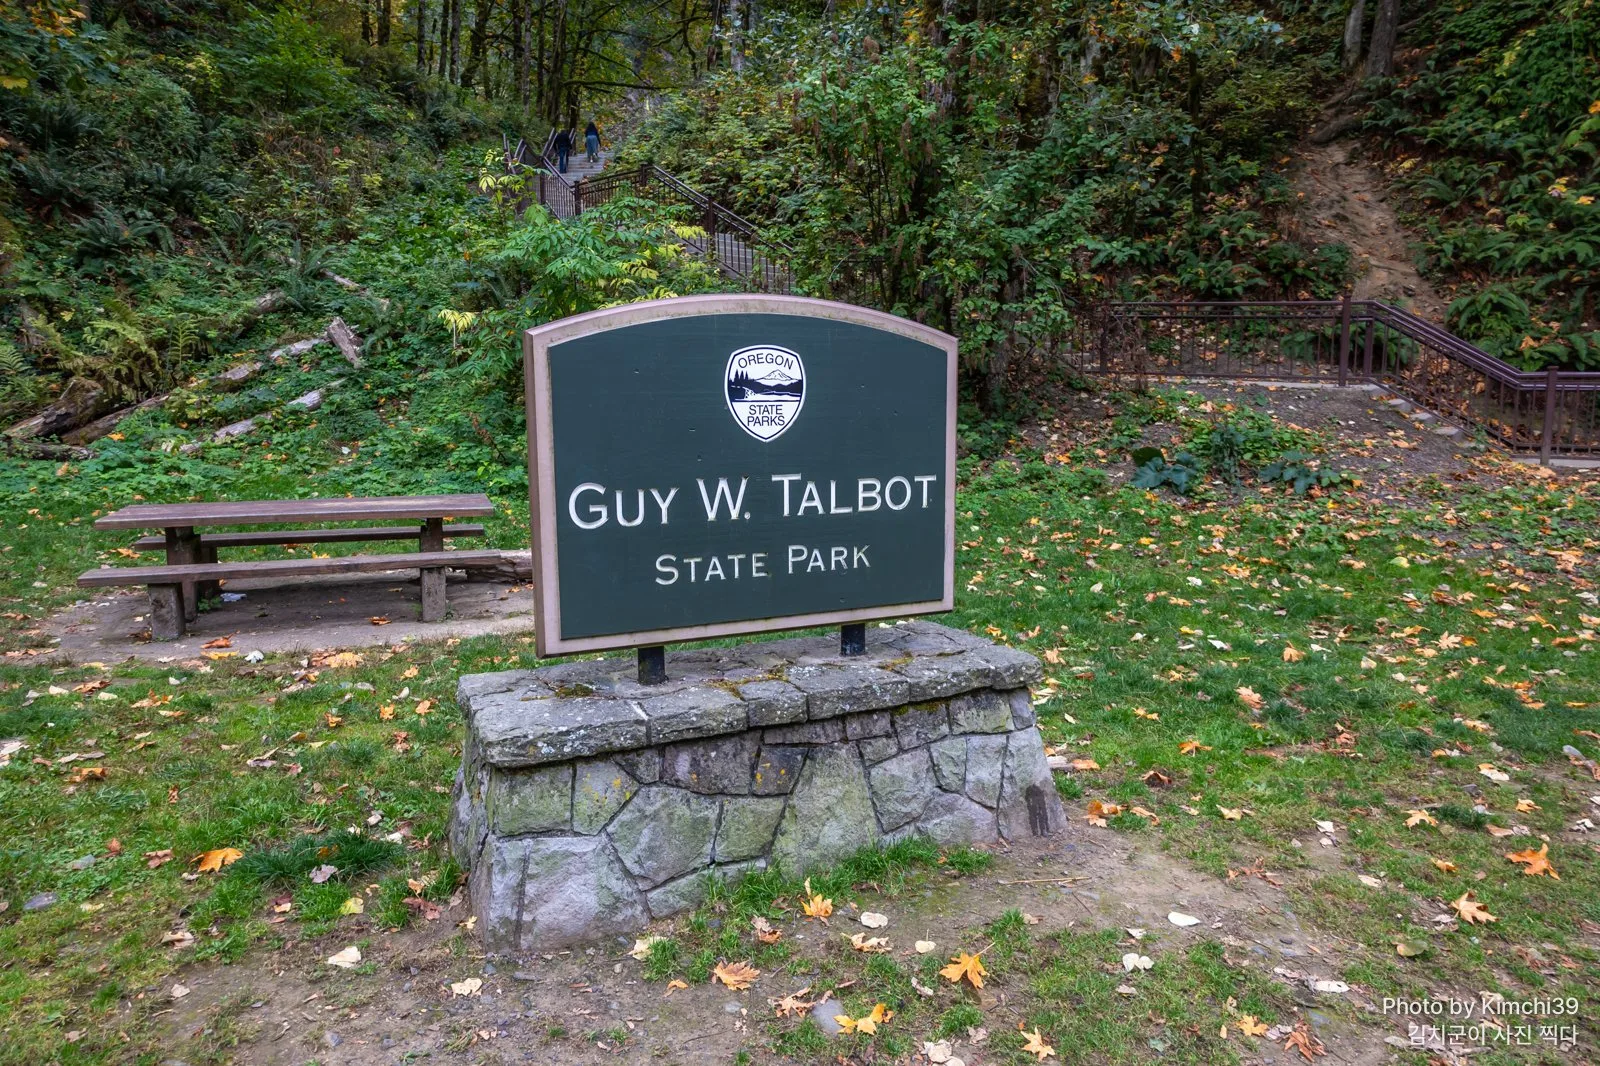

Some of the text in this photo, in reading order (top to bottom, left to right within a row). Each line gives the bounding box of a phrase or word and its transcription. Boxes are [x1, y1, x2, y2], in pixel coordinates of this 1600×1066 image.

[738, 353, 793, 370] OREGON
[749, 404, 783, 415] STATE
[747, 415, 785, 427] PARKS
[568, 473, 937, 529] GUY W. TALBOT
[655, 544, 871, 585] STATE PARK
